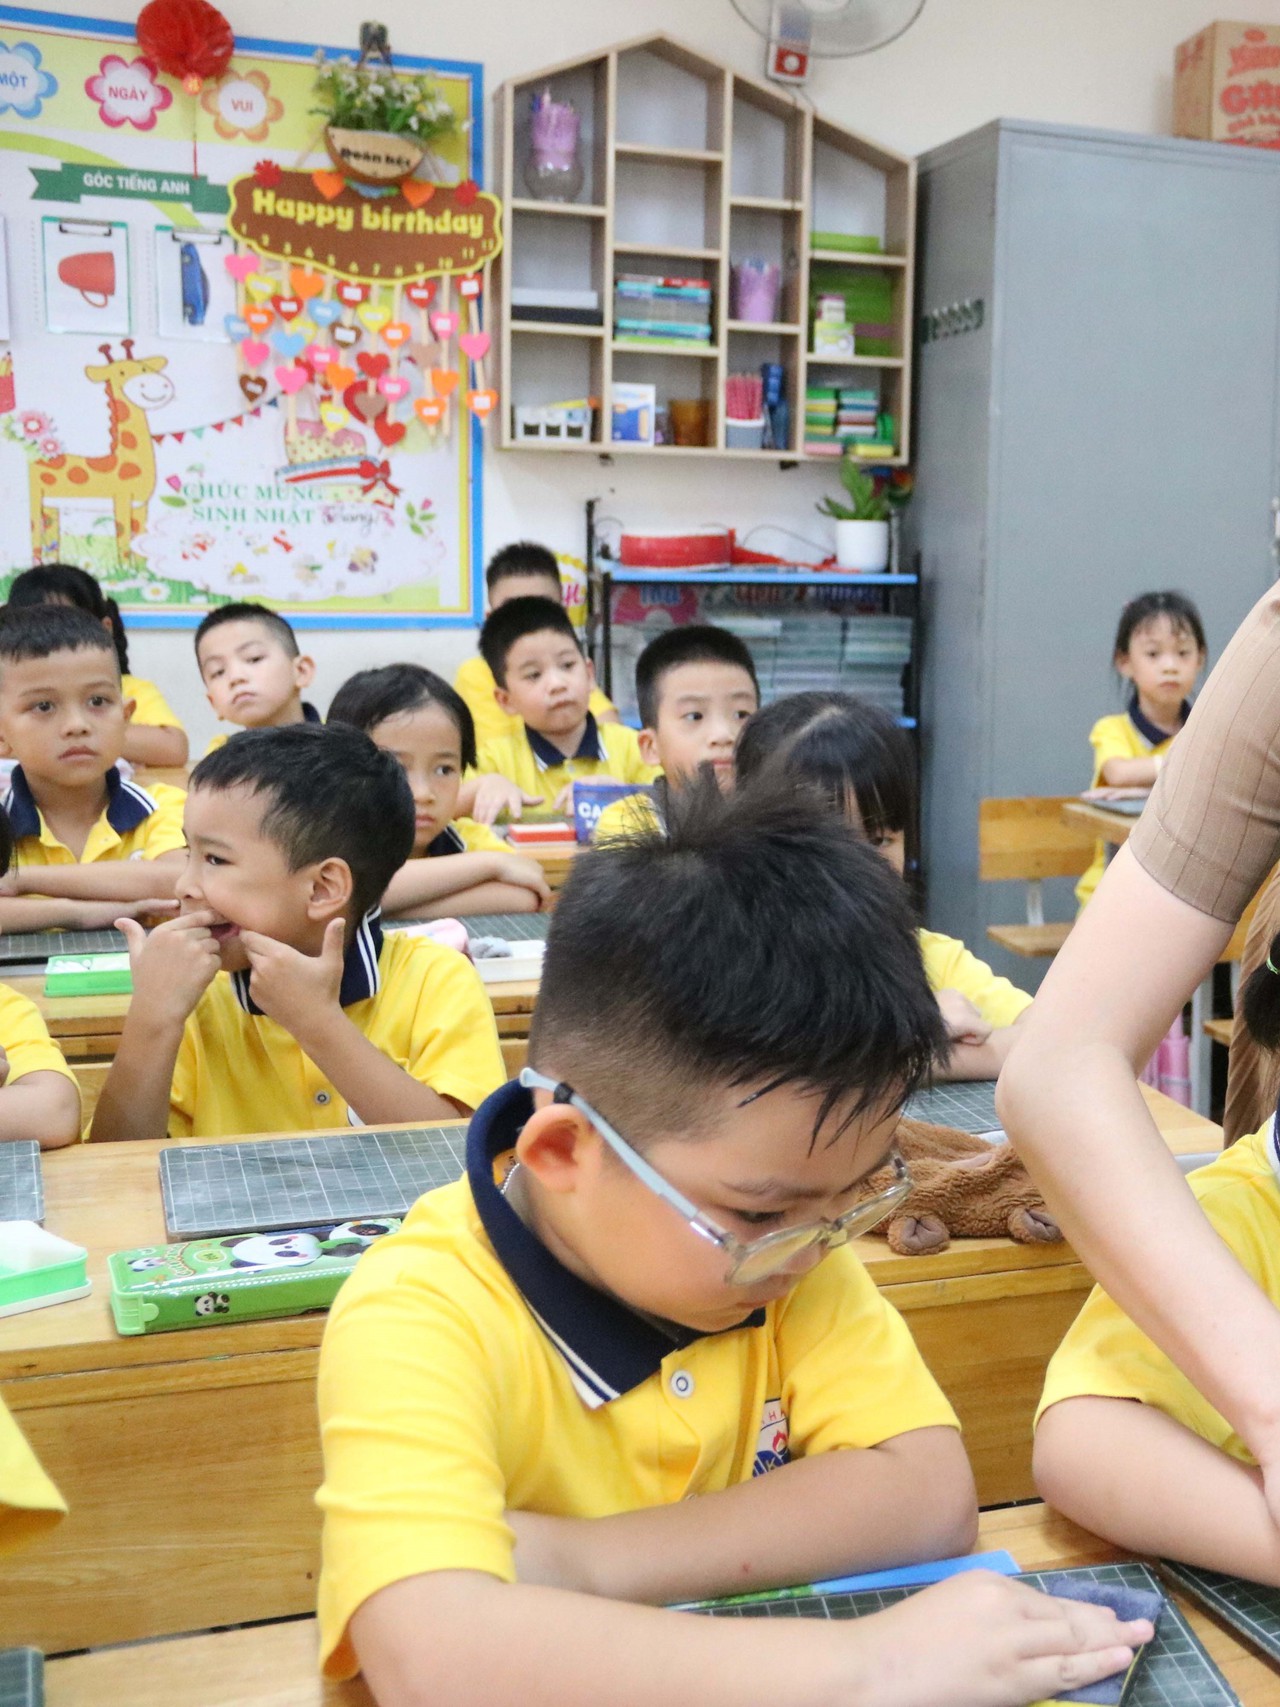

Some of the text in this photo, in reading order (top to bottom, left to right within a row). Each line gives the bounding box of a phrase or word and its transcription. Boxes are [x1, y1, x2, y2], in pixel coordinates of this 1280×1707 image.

[231, 98, 253, 112] VUI
[83, 171, 190, 195] GÓC TIẾNG ANH
[252, 189, 484, 239] Happy birthday
[193, 506, 247, 523] SINH
